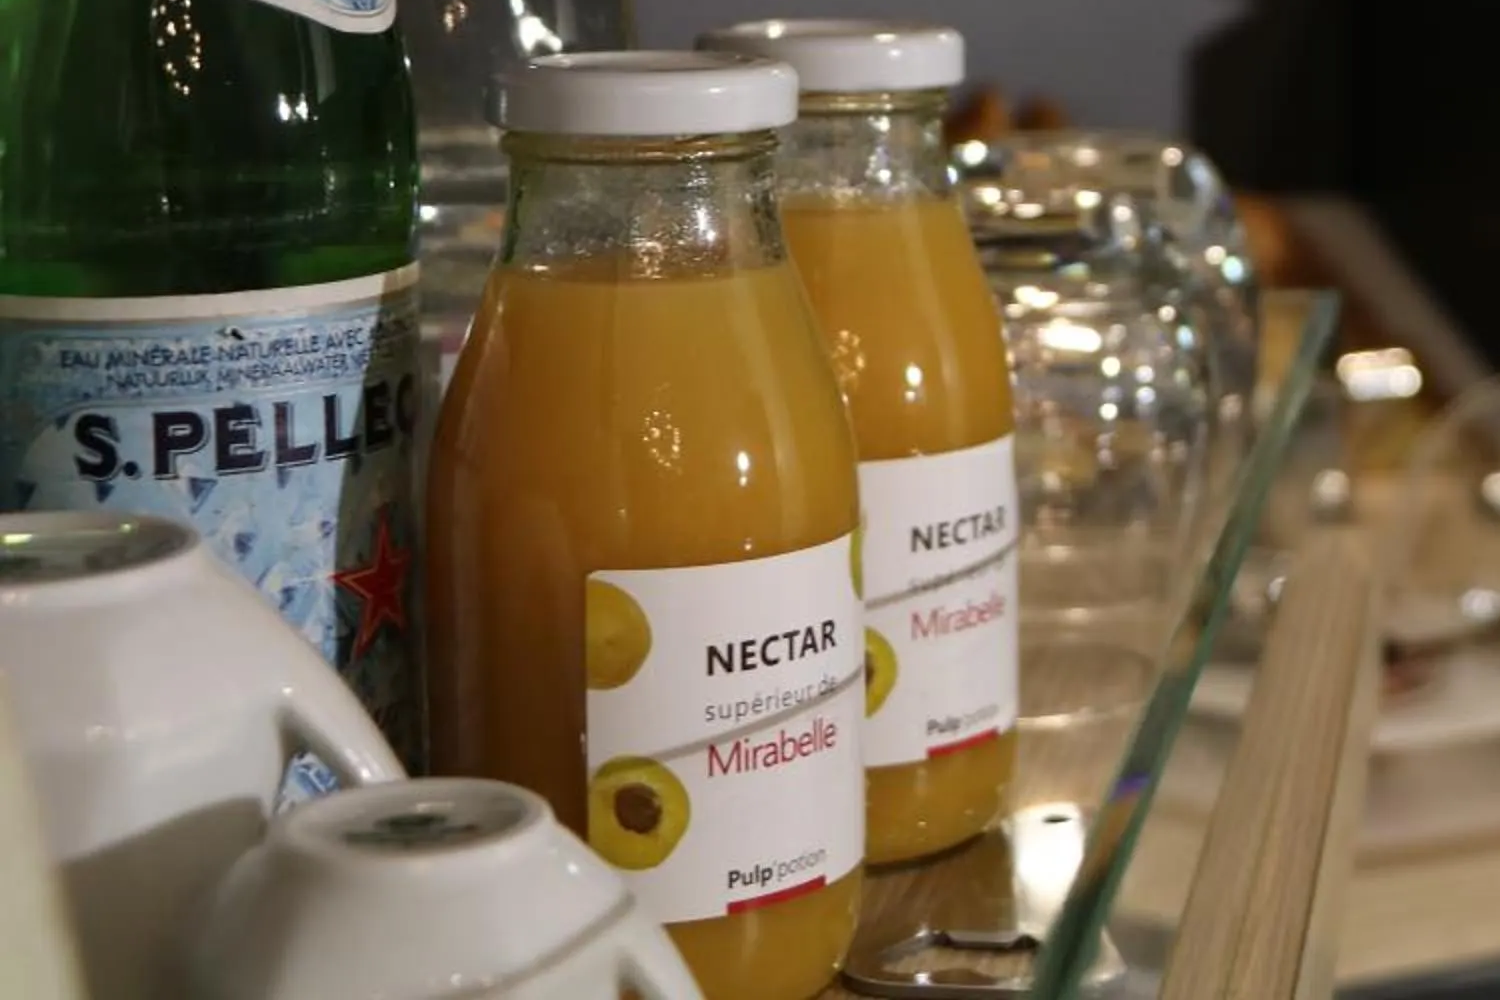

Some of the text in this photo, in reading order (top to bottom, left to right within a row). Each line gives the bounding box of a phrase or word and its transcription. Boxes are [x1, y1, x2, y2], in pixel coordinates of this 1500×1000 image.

[60, 346, 99, 369] EAU
[215, 333, 320, 361] NATURELLE
[705, 619, 837, 676] NECTAR
[704, 682, 814, 723] supérieur
[707, 717, 838, 779] Mirabelle
